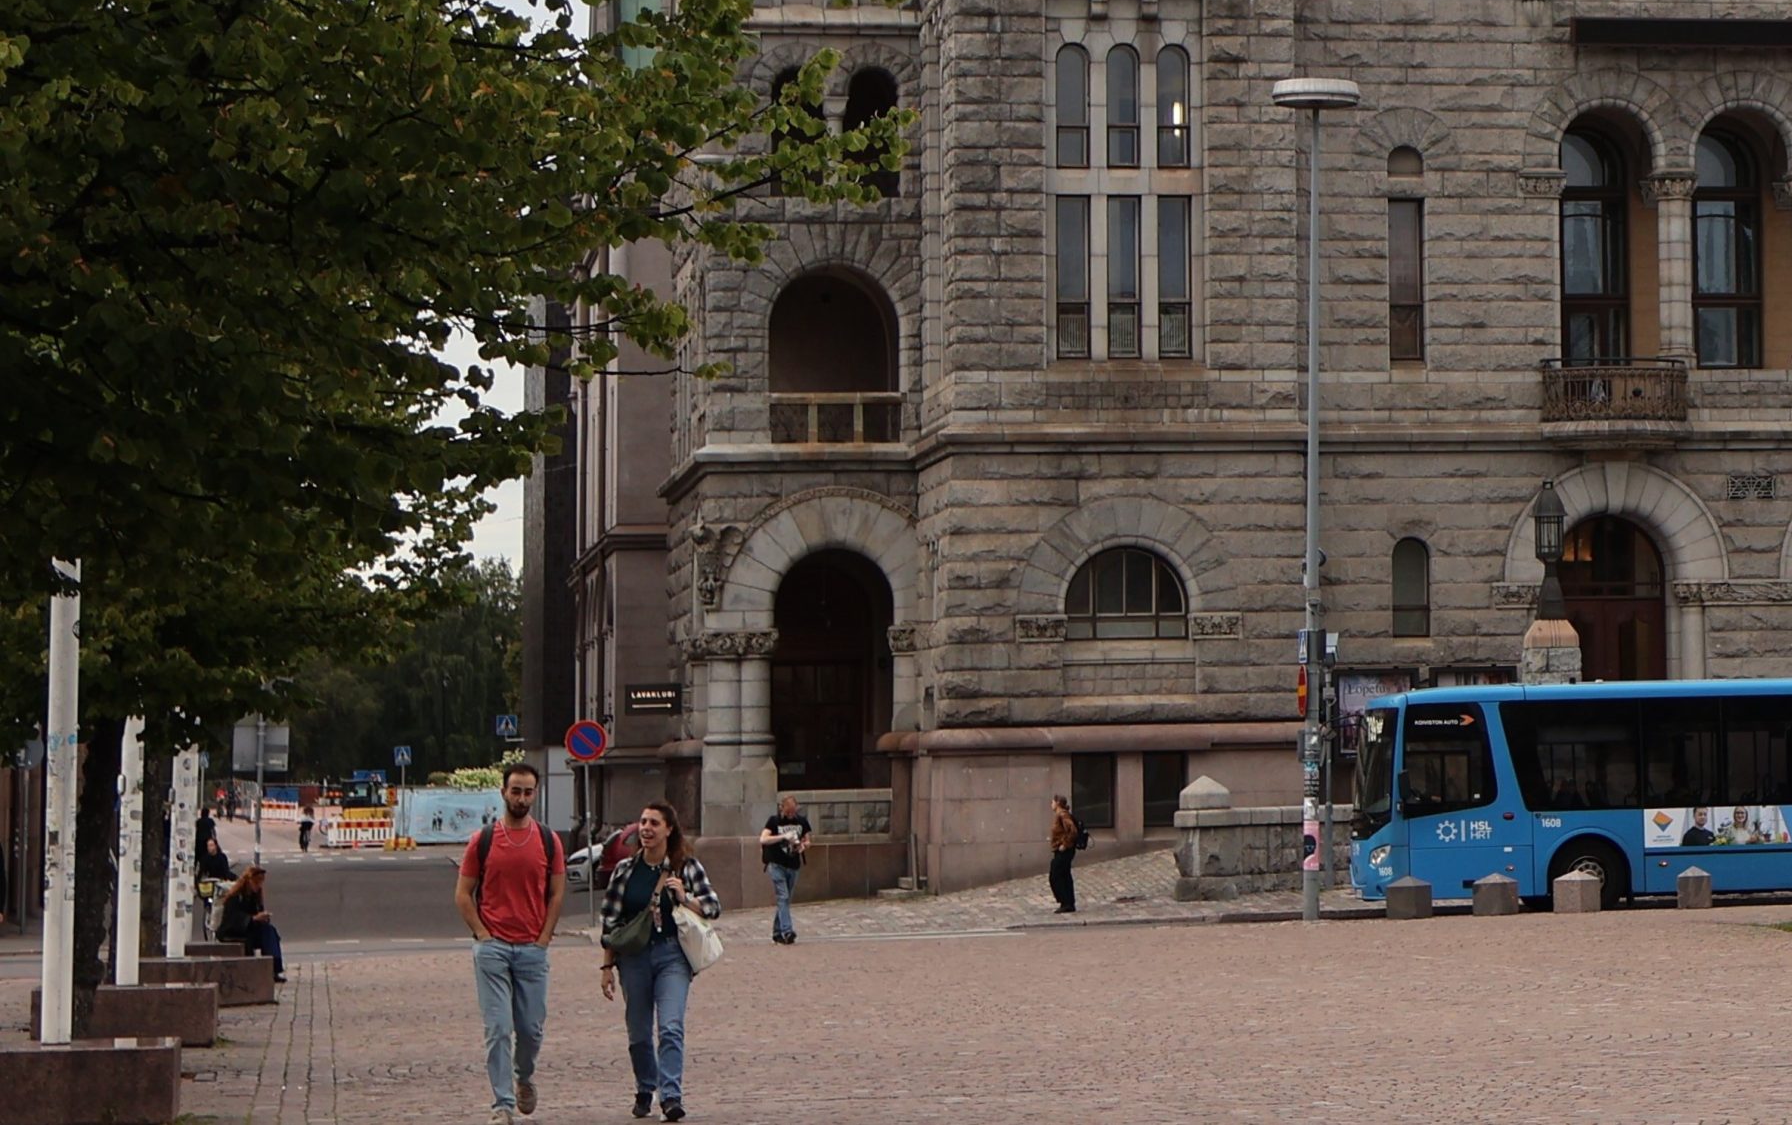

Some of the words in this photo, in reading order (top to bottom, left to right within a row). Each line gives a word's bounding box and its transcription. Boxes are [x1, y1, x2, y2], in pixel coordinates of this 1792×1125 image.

[1470, 821, 1492, 830] HSL
[1541, 818, 1562, 828] 1608
[1470, 830, 1492, 840] HRT
[1378, 867, 1394, 876] 1608
